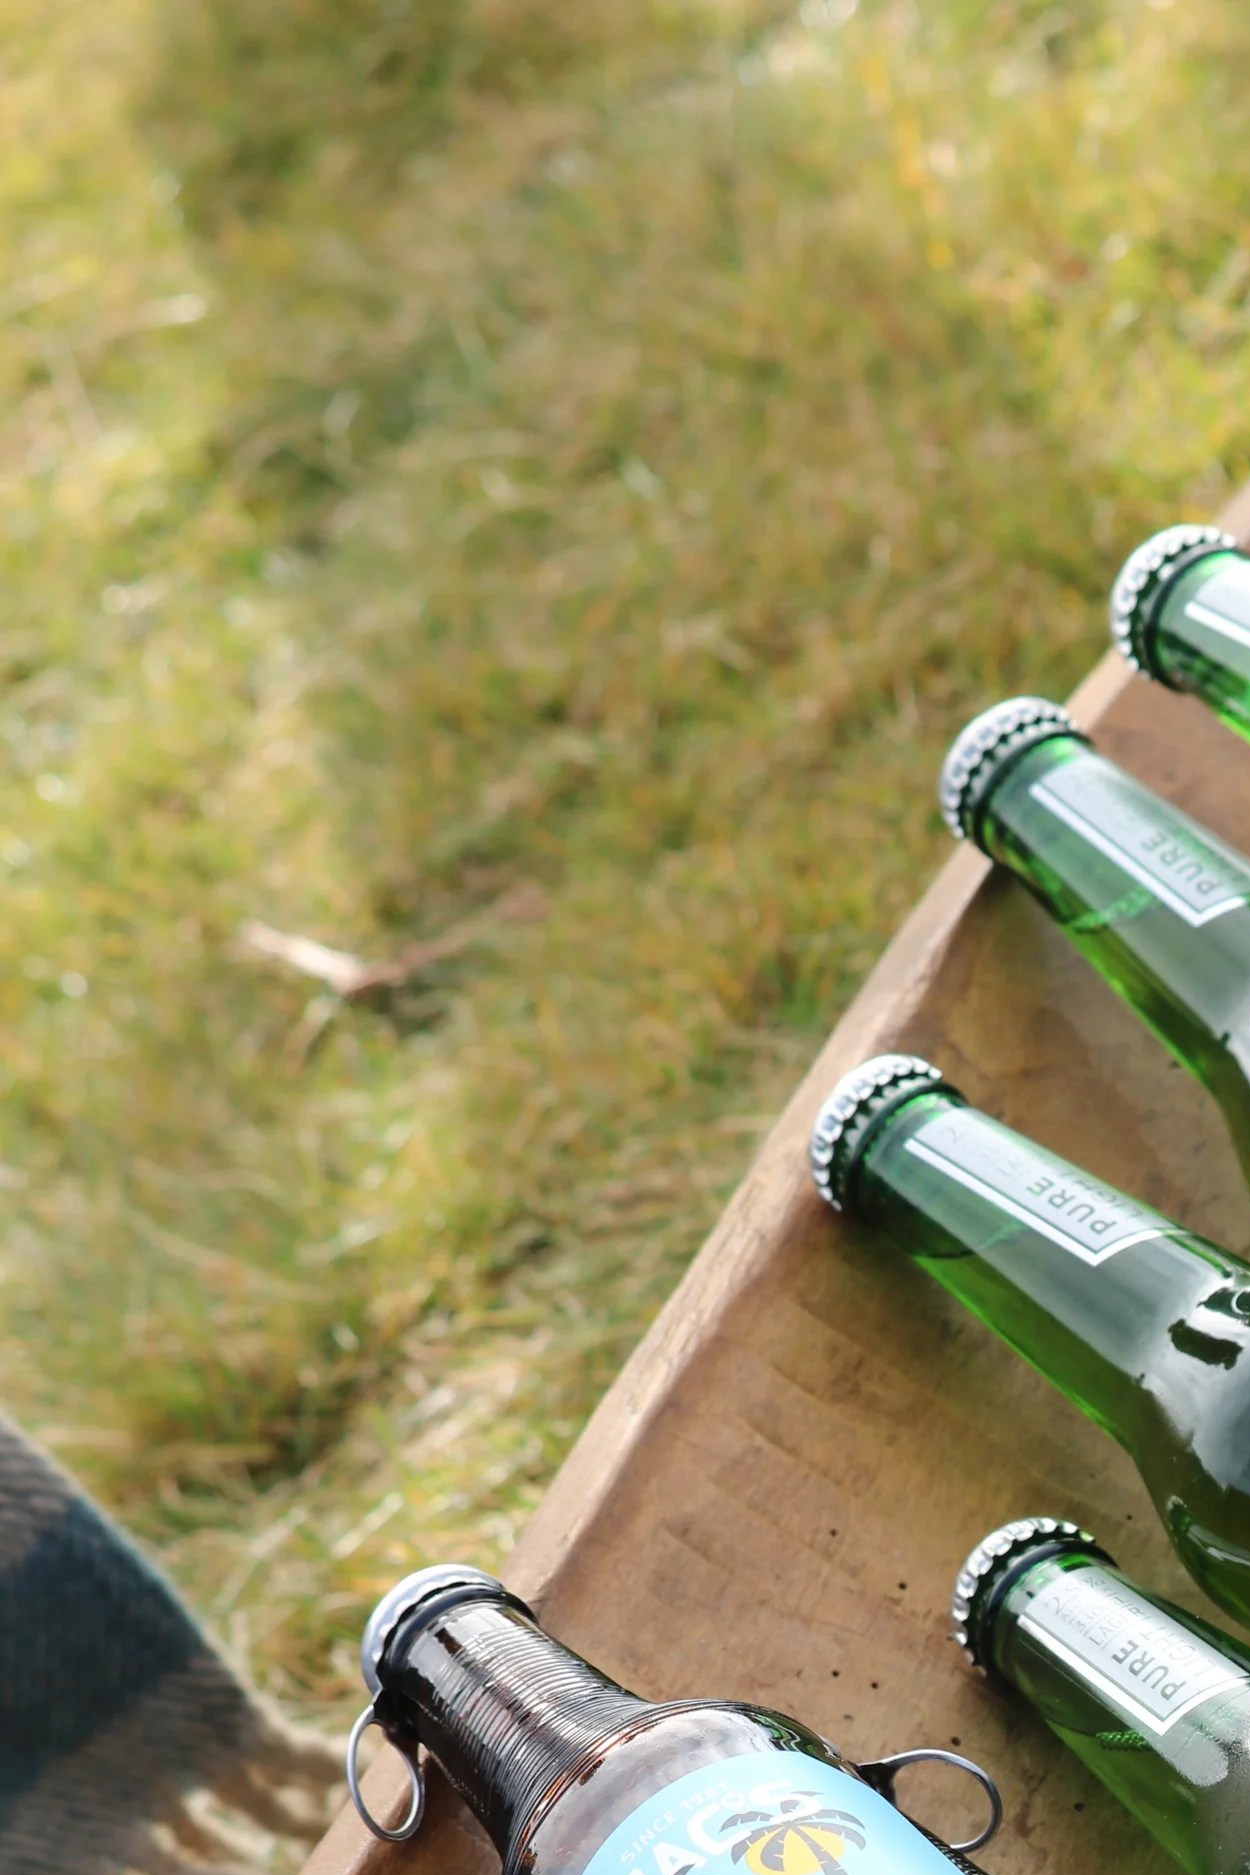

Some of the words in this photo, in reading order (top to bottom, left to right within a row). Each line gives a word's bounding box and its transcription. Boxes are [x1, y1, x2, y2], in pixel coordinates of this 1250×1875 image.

[1140, 829, 1224, 896] PURE
[1026, 1175, 1118, 1246] PURE
[1111, 1639, 1188, 1701] PURE
[619, 1809, 679, 1867] SINCE
